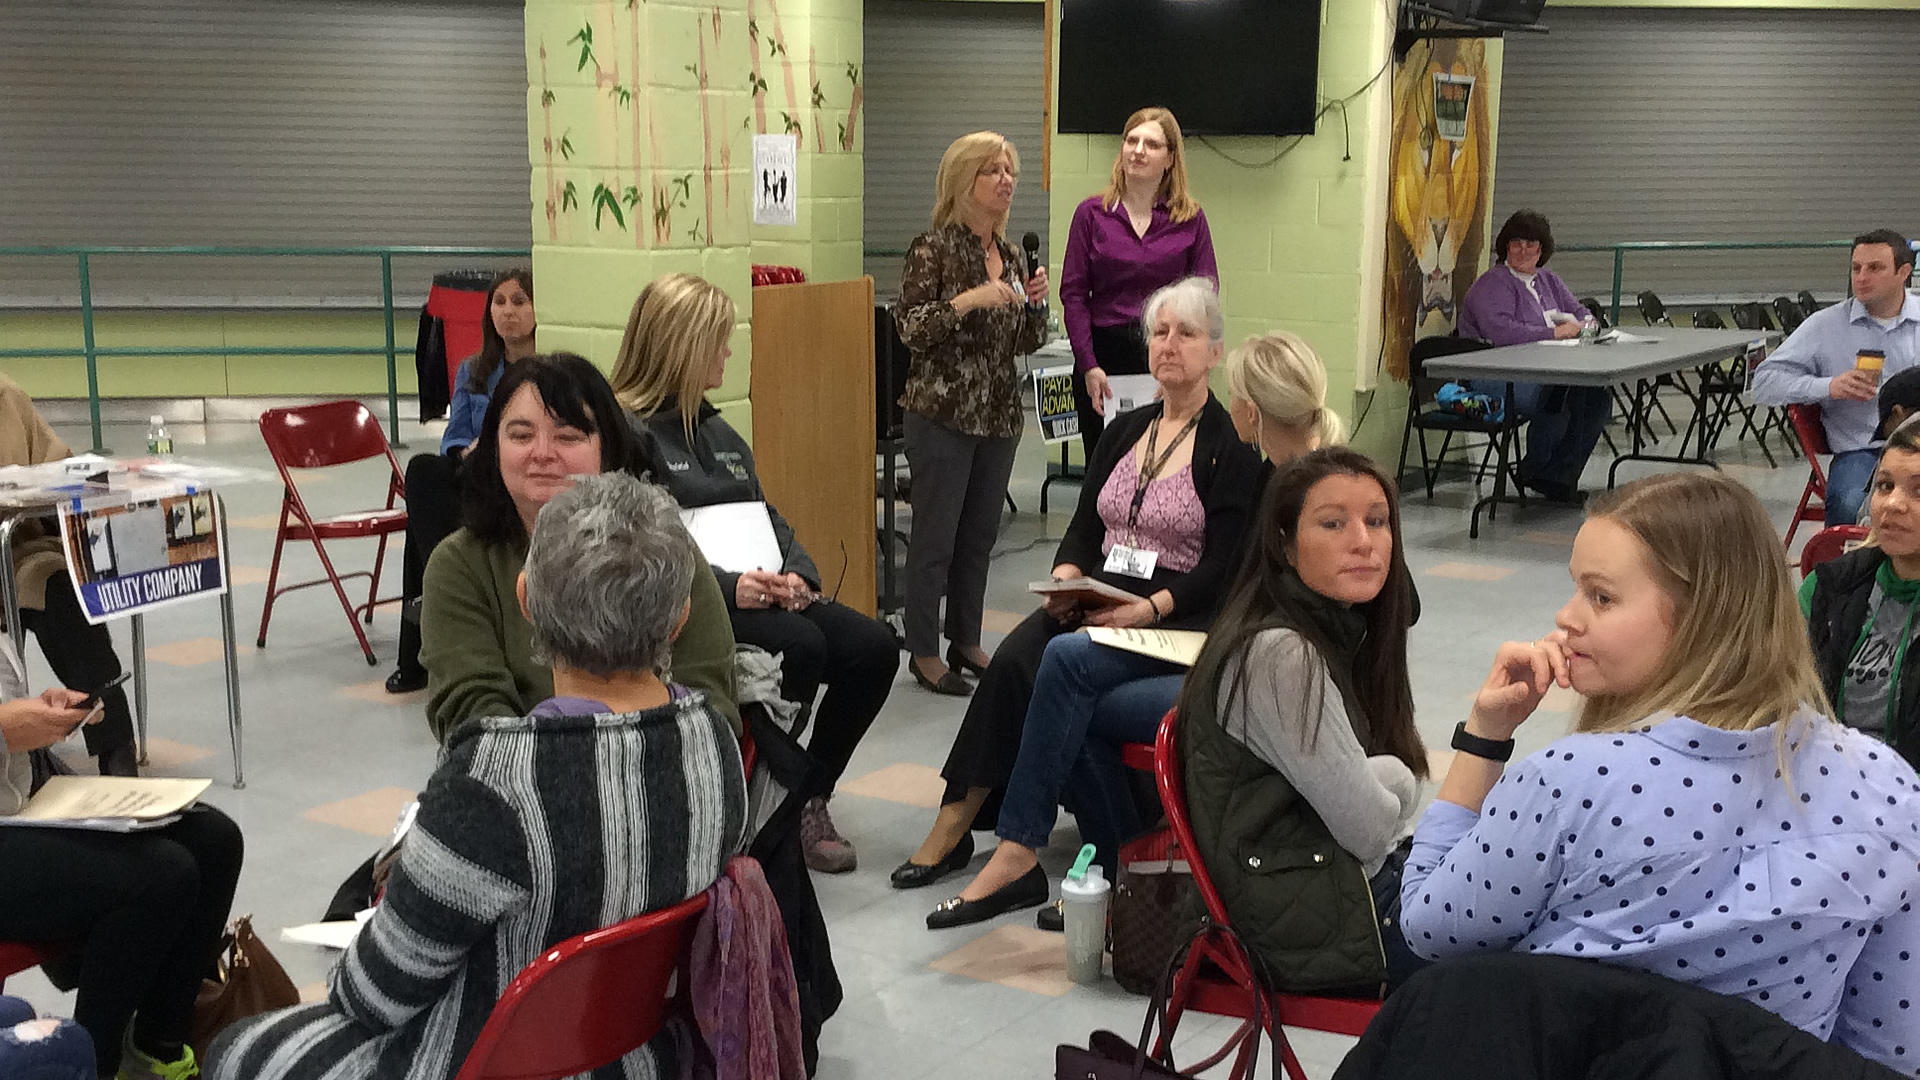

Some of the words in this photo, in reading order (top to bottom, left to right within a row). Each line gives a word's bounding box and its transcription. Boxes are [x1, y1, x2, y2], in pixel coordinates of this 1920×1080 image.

[1043, 375, 1073, 394] PAYD
[97, 575, 141, 612] UTILITY
[143, 563, 203, 602] COMPANY
